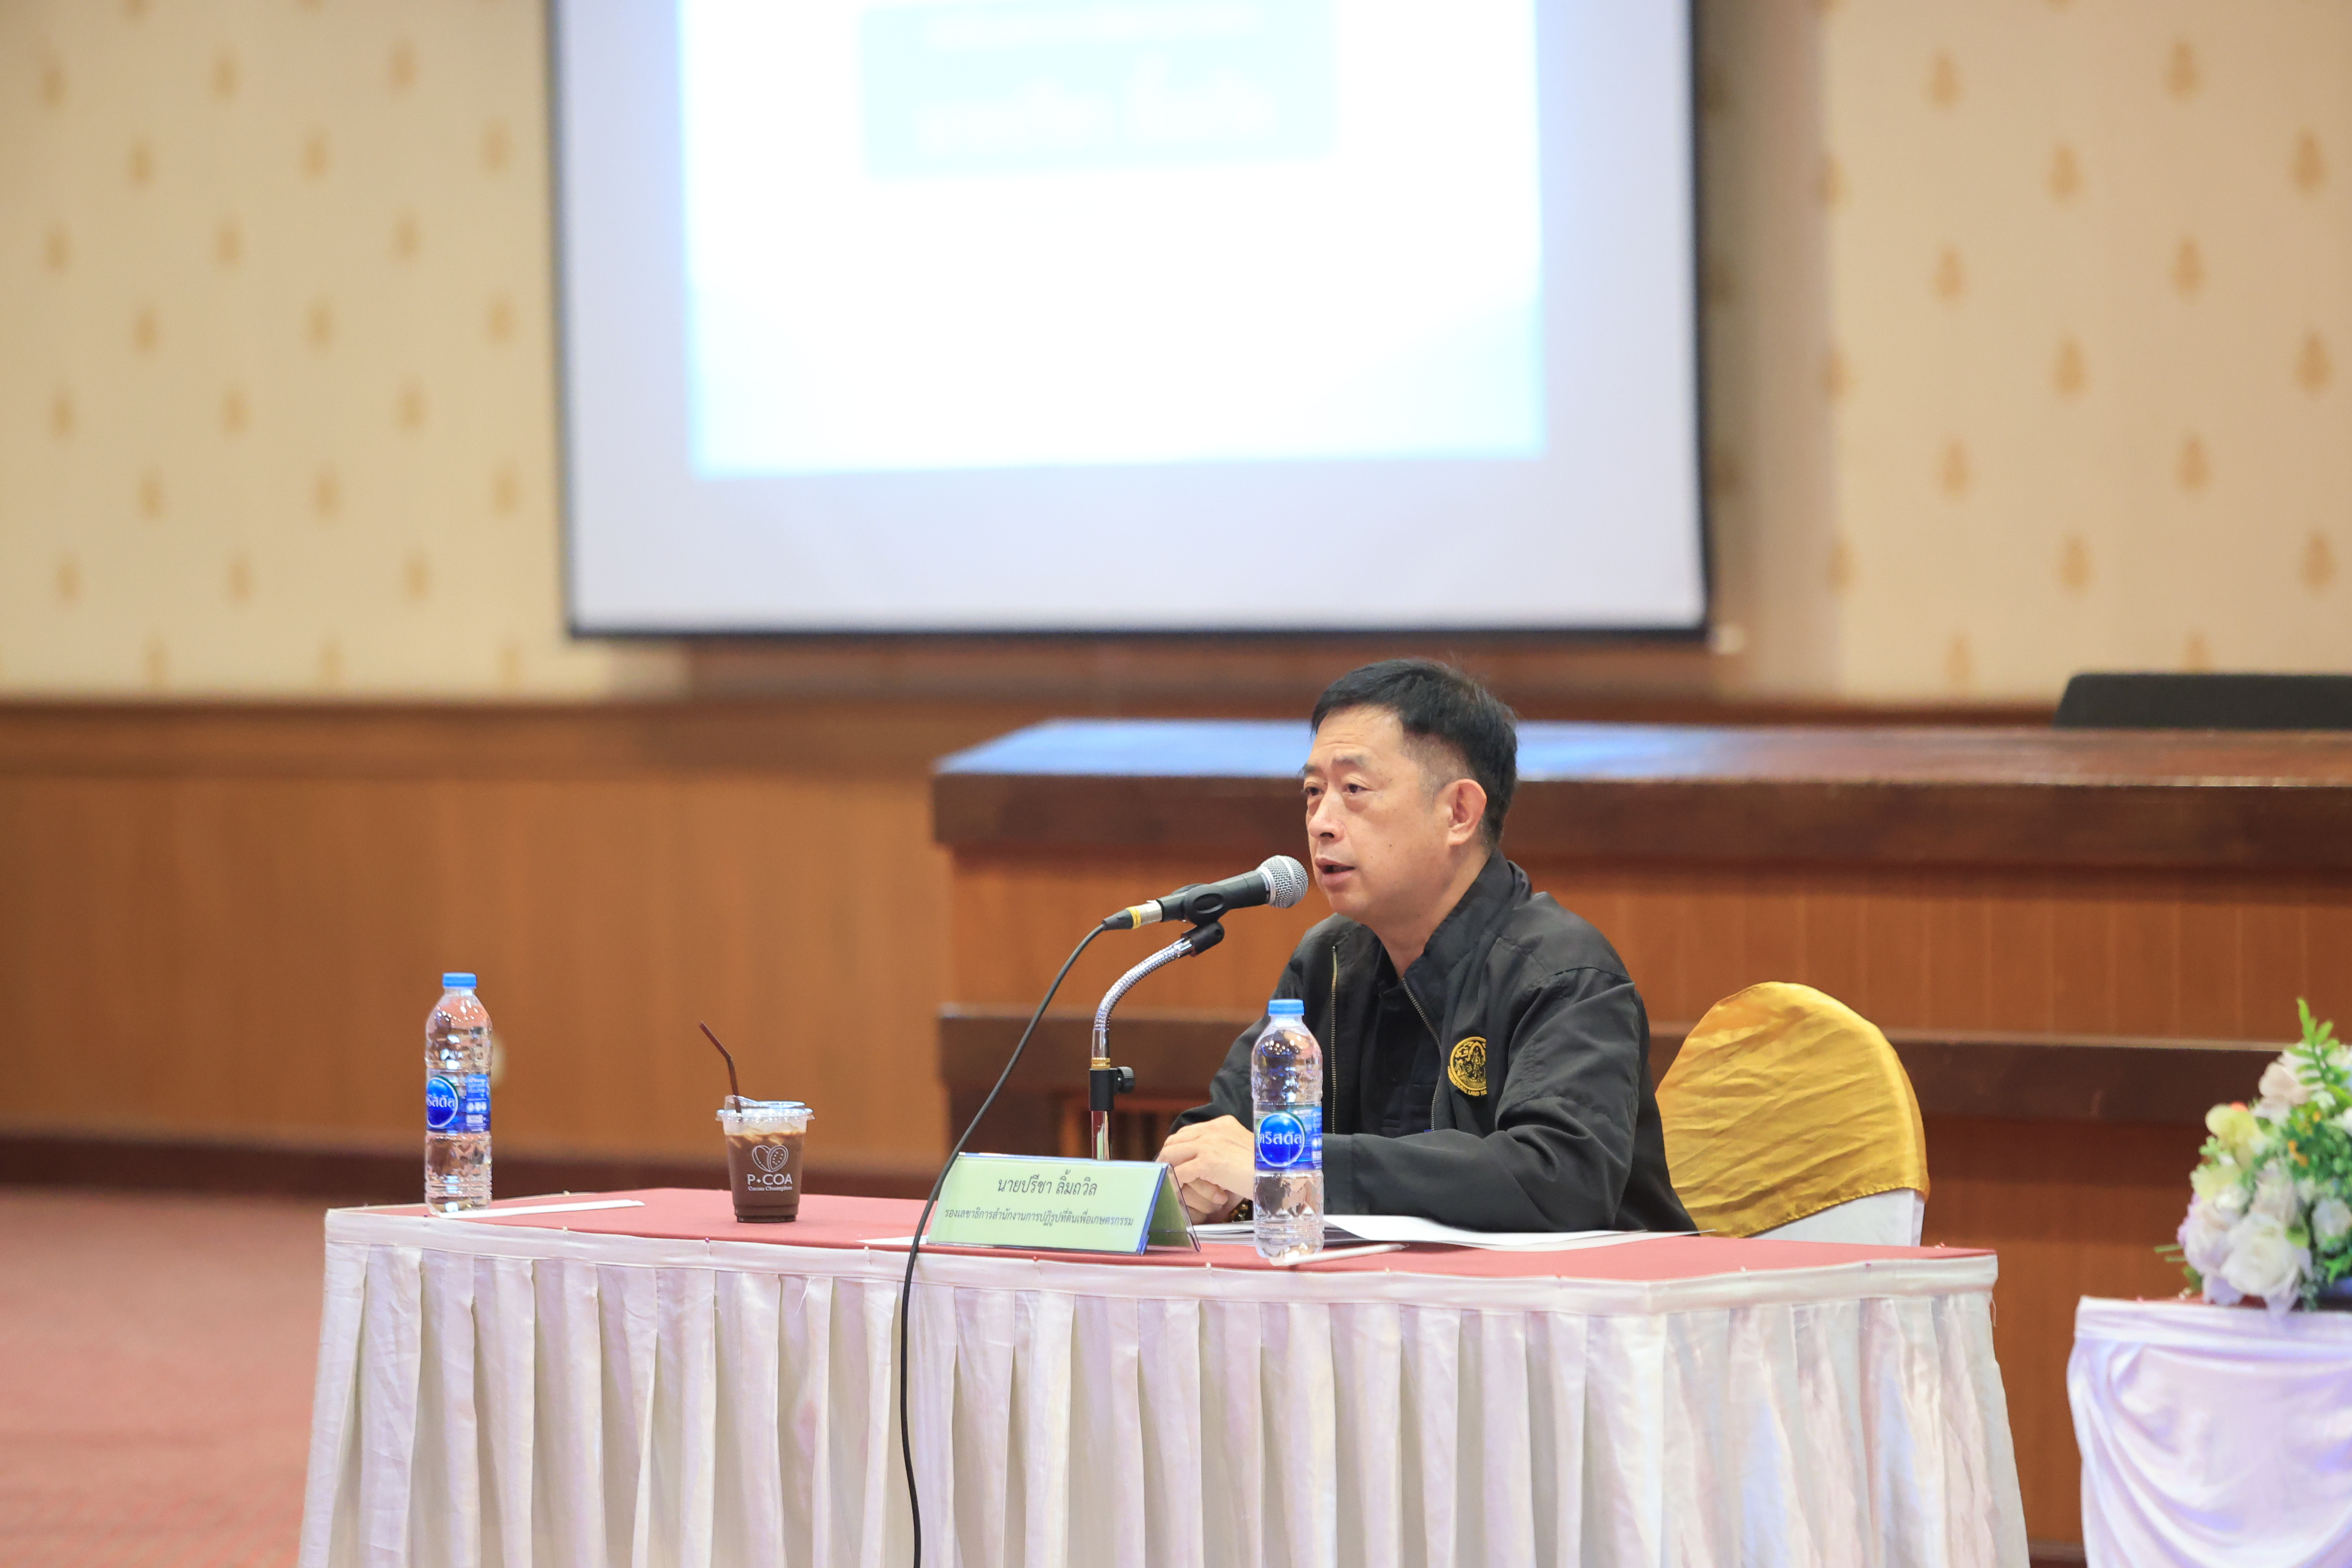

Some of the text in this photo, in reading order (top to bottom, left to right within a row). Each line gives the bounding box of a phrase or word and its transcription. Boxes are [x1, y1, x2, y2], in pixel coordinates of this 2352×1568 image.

[998, 1170, 1097, 1196] นายปรีชา ลิ้มถวิล
